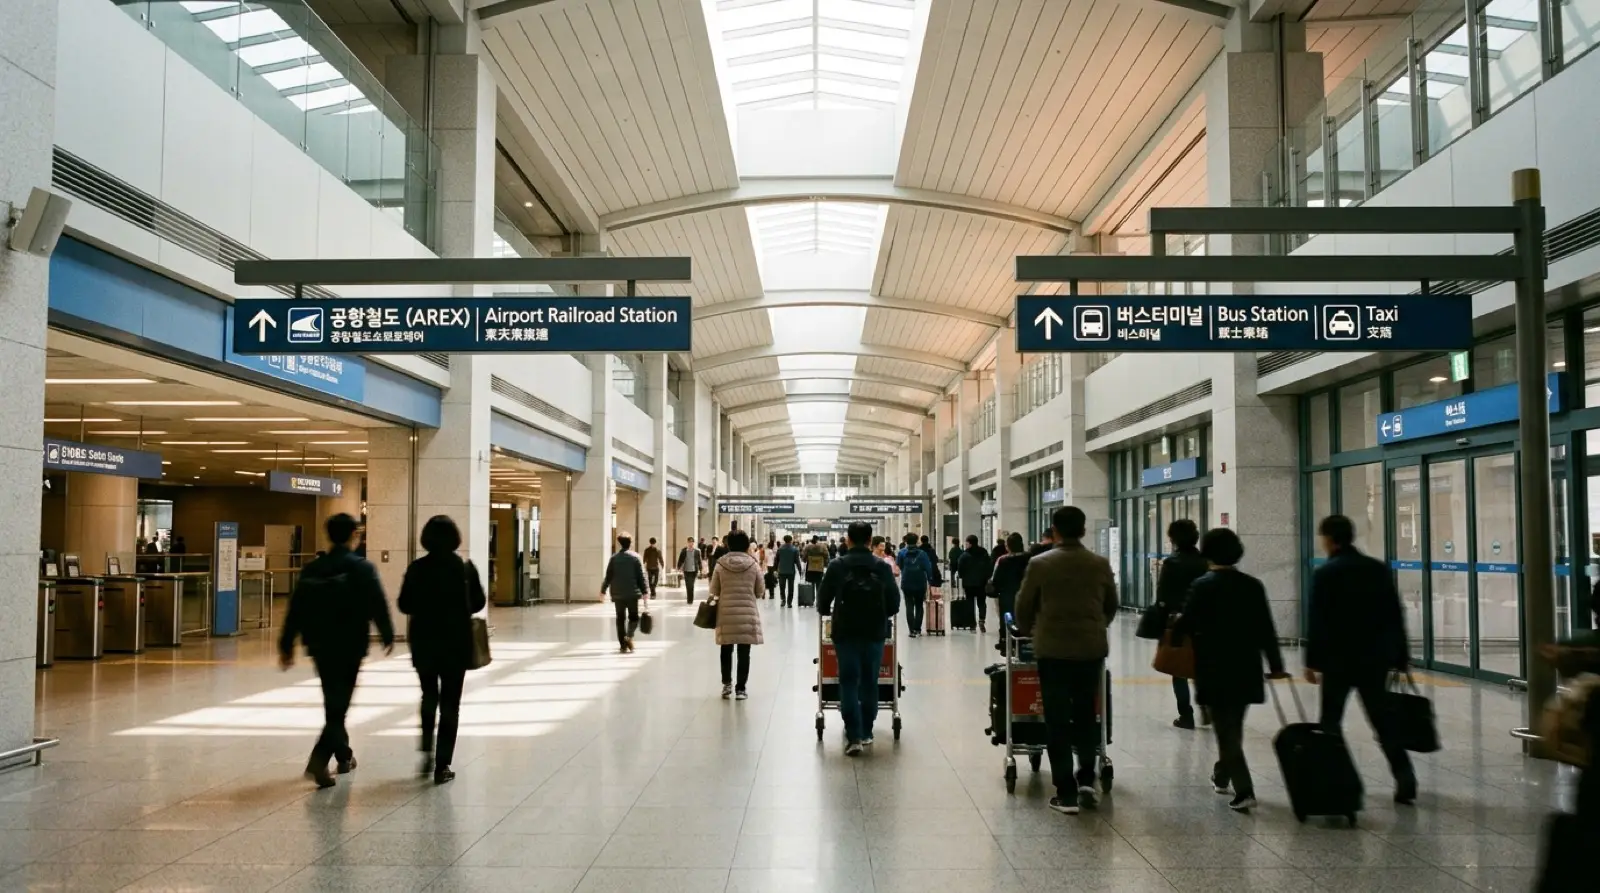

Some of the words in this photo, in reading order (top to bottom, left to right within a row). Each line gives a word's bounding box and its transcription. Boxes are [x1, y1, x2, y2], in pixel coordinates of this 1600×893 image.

[330, 307, 400, 328] 공항철도
[405, 307, 471, 328] (AREX)
[484, 307, 544, 326] Airport
[548, 307, 615, 323] Railroad
[619, 307, 678, 323] Station
[1117, 305, 1203, 326] 버스터미널
[1218, 305, 1247, 322] Bus
[1250, 305, 1309, 322] Station
[1366, 305, 1399, 322] Taxi
